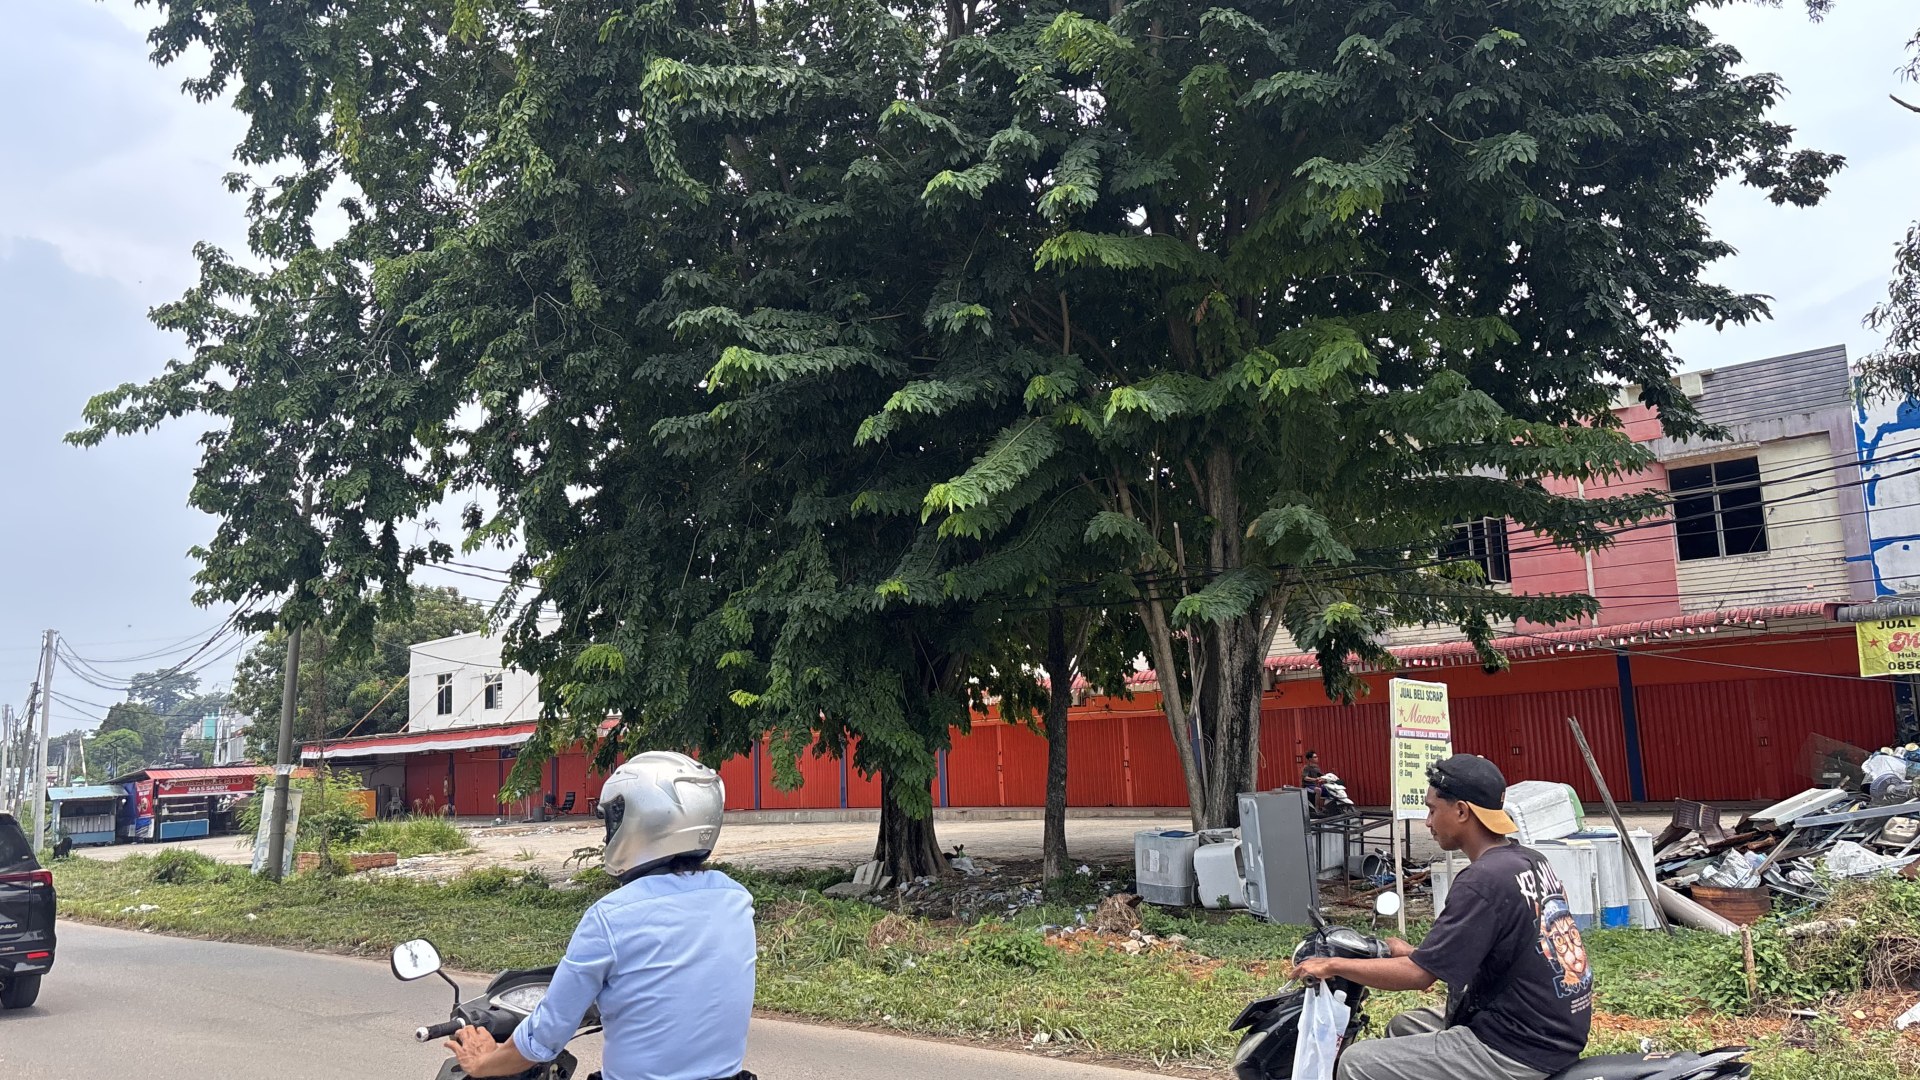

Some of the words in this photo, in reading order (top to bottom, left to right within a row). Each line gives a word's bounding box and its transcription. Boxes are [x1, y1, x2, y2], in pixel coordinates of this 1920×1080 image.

[1877, 619, 1916, 630] JUAL
[1400, 687, 1412, 699] JUAL
[1413, 689, 1425, 700] BELI
[1425, 690, 1443, 702] SCRAP
[1403, 703, 1441, 725] Macaro
[1402, 794, 1419, 805] 0858
